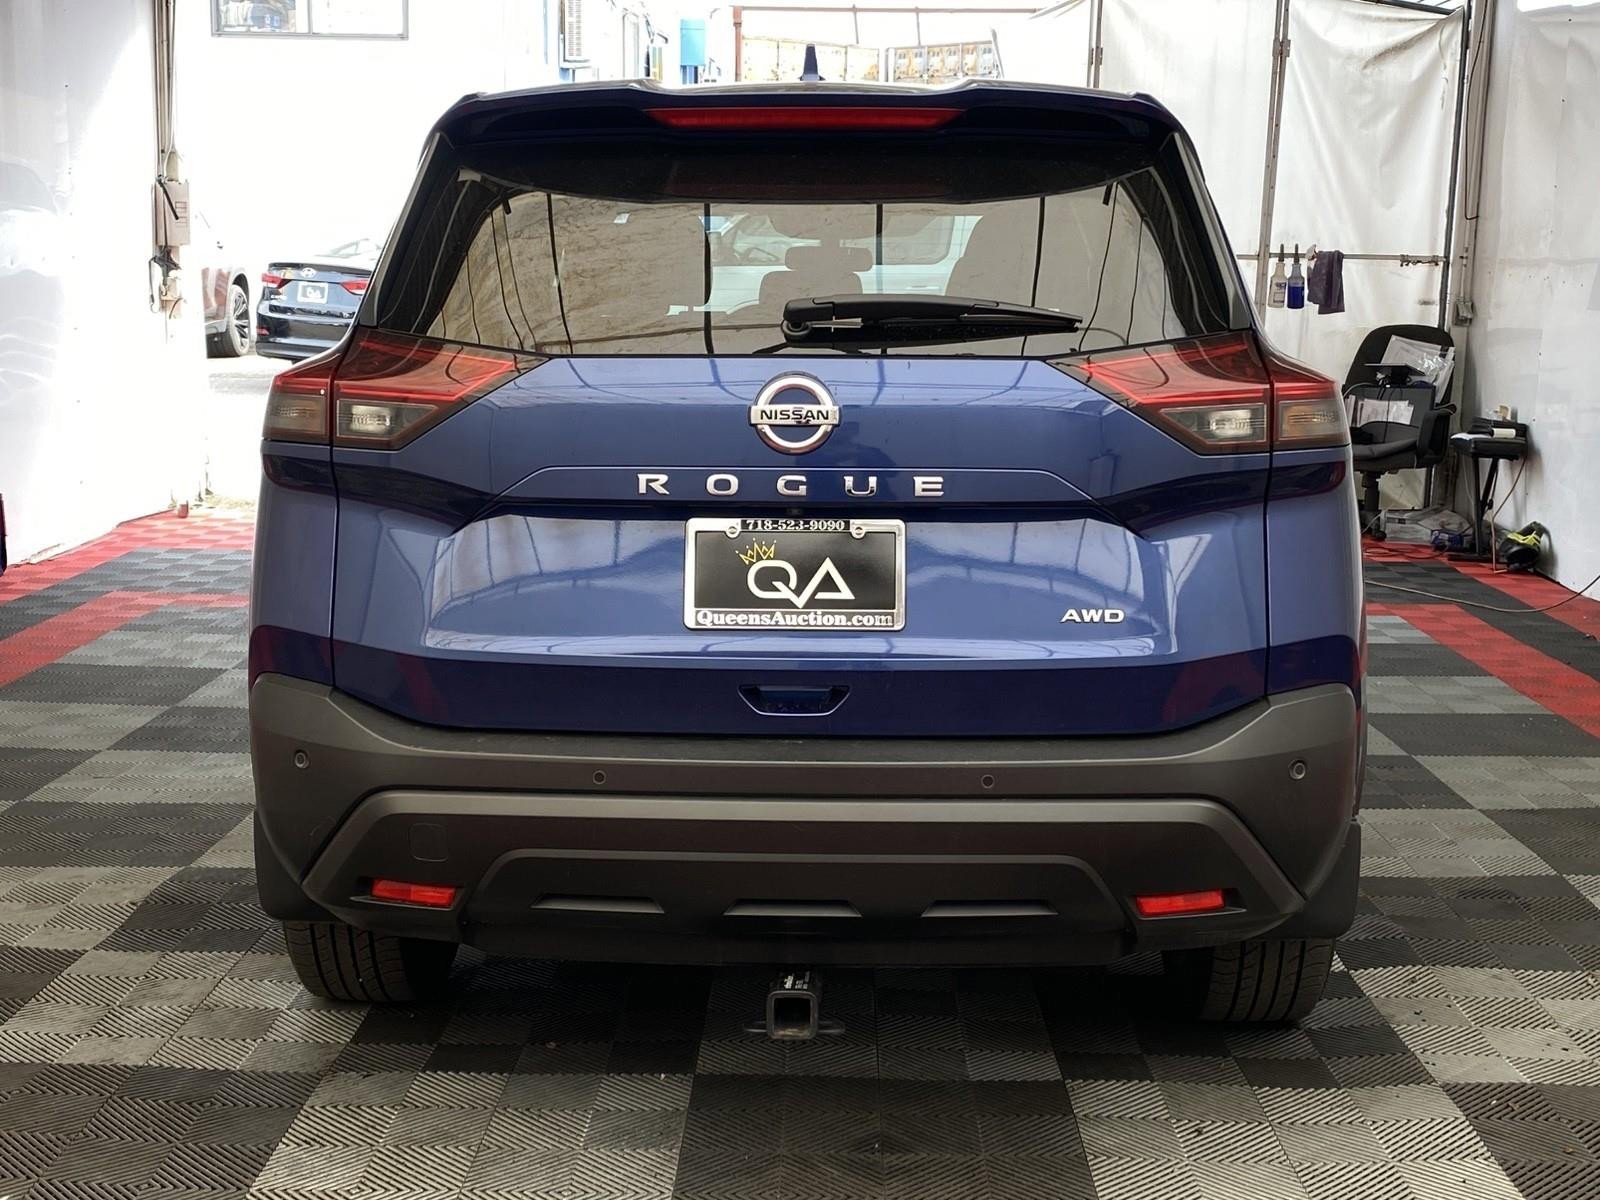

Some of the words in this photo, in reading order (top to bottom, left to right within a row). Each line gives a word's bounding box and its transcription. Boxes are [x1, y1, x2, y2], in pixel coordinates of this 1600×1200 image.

[760, 409, 829, 421] NISSAN
[637, 473, 945, 497] ROGUE
[746, 519, 846, 532] 718-523-9090
[747, 556, 856, 609] QA
[697, 610, 893, 628] QueensAuction.com
[1060, 608, 1125, 623] AWD
